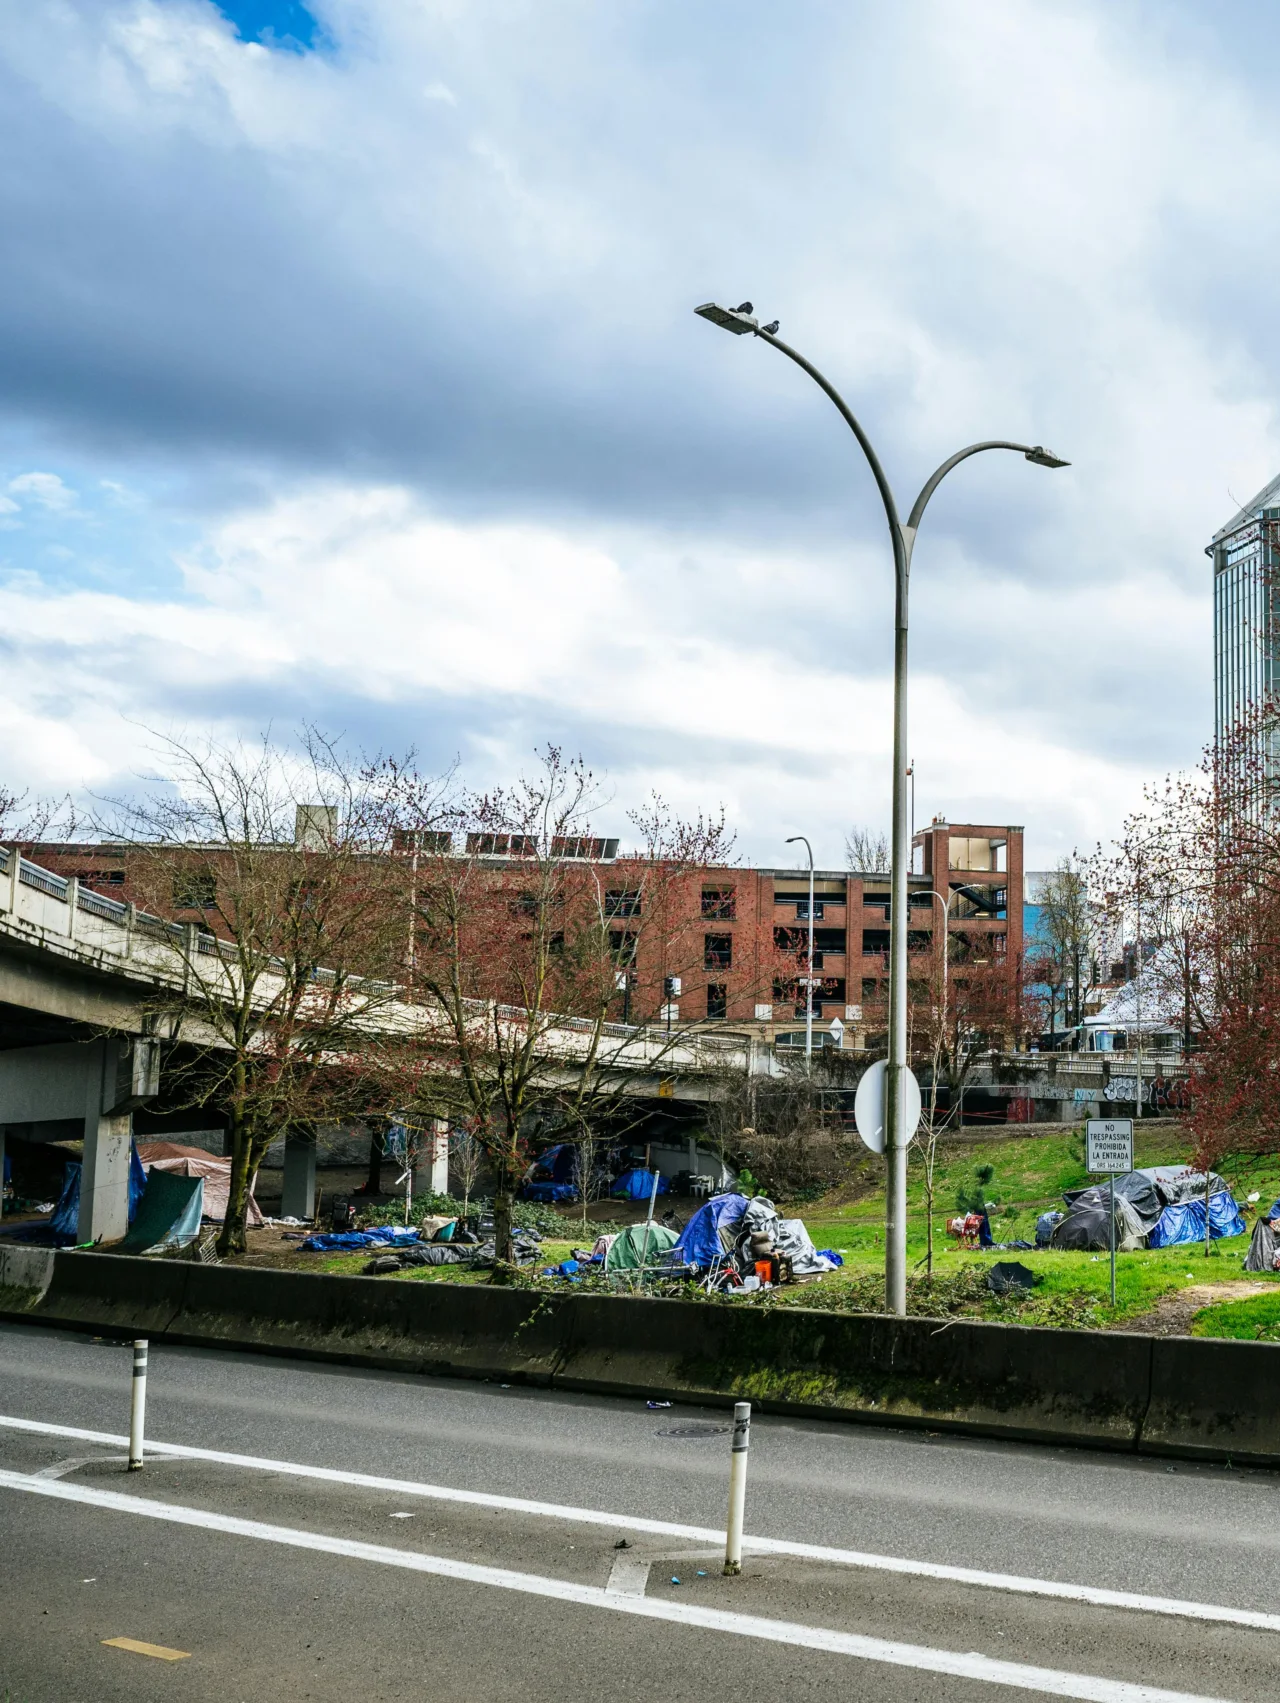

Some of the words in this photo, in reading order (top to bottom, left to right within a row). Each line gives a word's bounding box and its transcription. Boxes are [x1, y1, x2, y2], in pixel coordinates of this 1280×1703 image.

[1090, 1133, 1130, 1141] TRESPASSING
[1094, 1142, 1127, 1150] PROHIBIDA
[1102, 1152, 1129, 1160] ENTRADA
